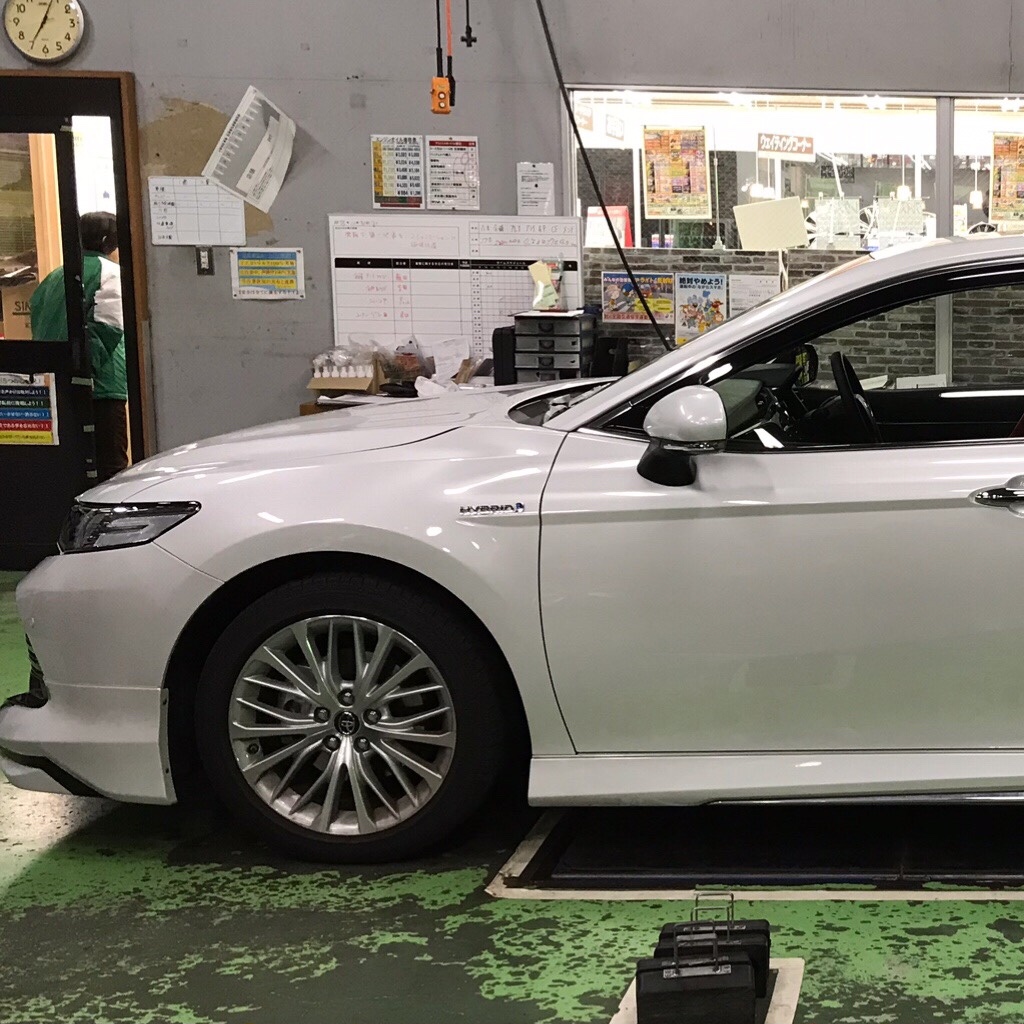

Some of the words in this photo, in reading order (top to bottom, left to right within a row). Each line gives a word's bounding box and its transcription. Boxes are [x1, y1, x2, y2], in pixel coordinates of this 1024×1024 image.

[16, 4, 26, 13] 10
[13, 17, 20, 27] 9
[69, 18, 76, 28] 3
[18, 30, 25, 40] 8
[64, 32, 72, 41] 4
[42, 44, 49, 54] 6
[55, 41, 63, 51] 5
